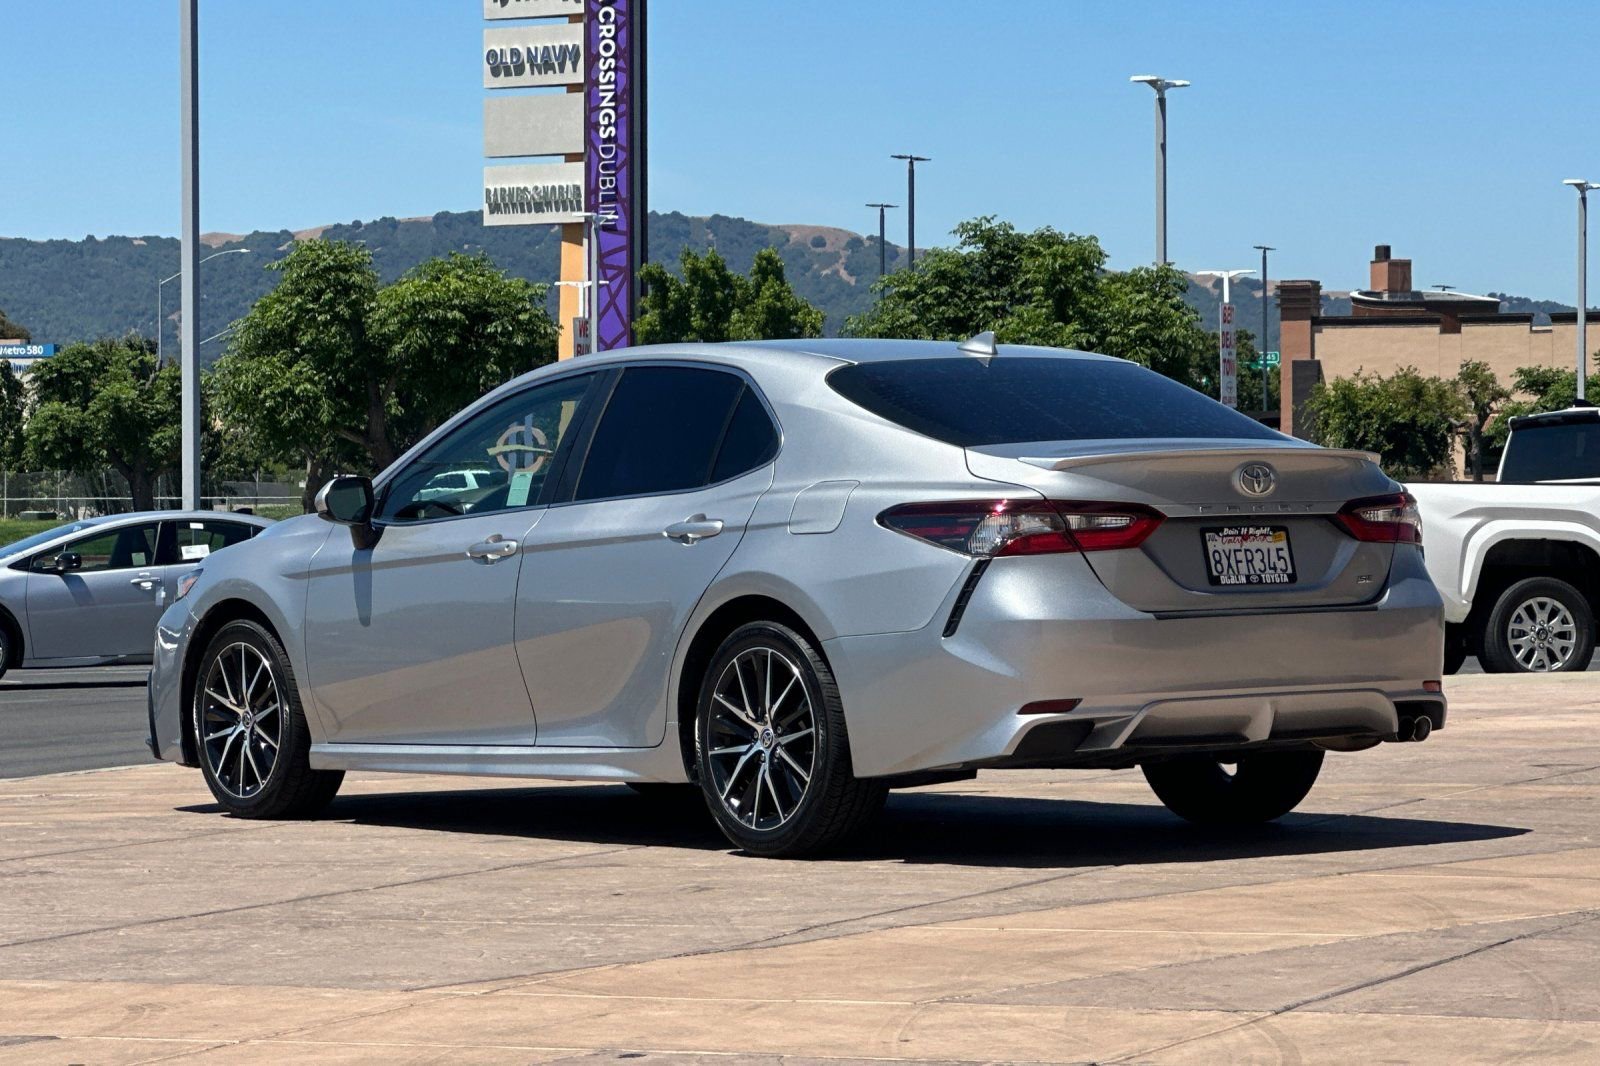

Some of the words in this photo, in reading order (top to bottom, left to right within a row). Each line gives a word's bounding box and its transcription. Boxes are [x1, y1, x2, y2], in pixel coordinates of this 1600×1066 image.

[526, 44, 581, 65] NAVY
[598, 6, 616, 139] CROSSINGS
[598, 144, 616, 226] DUBLIN
[0, 346, 26, 355] Metro
[27, 345, 44, 355] 580
[1212, 547, 1288, 575] 8XFR345
[1261, 574, 1289, 584] TOYOTA
